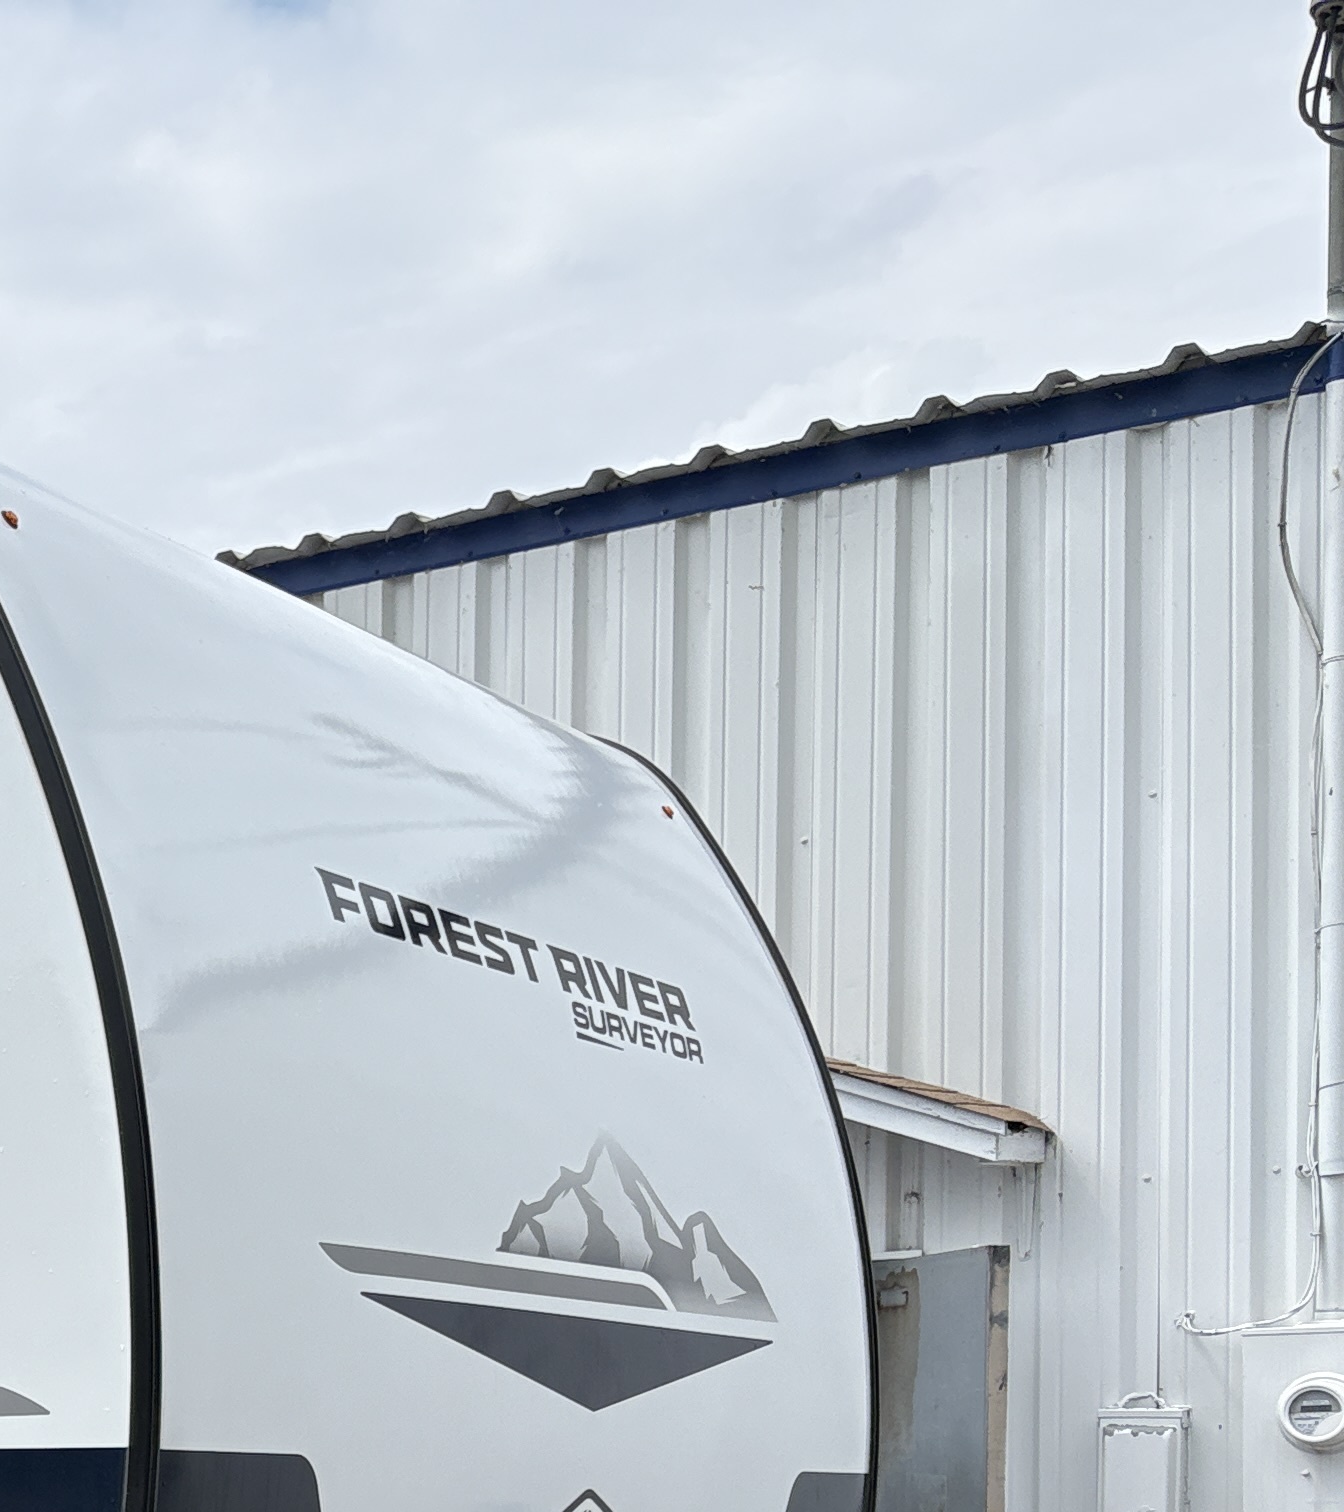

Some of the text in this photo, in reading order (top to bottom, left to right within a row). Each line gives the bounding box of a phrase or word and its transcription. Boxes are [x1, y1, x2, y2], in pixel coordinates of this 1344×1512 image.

[313, 866, 695, 1031] FOREST RIVER
[572, 1001, 704, 1064] SURVEYOR
